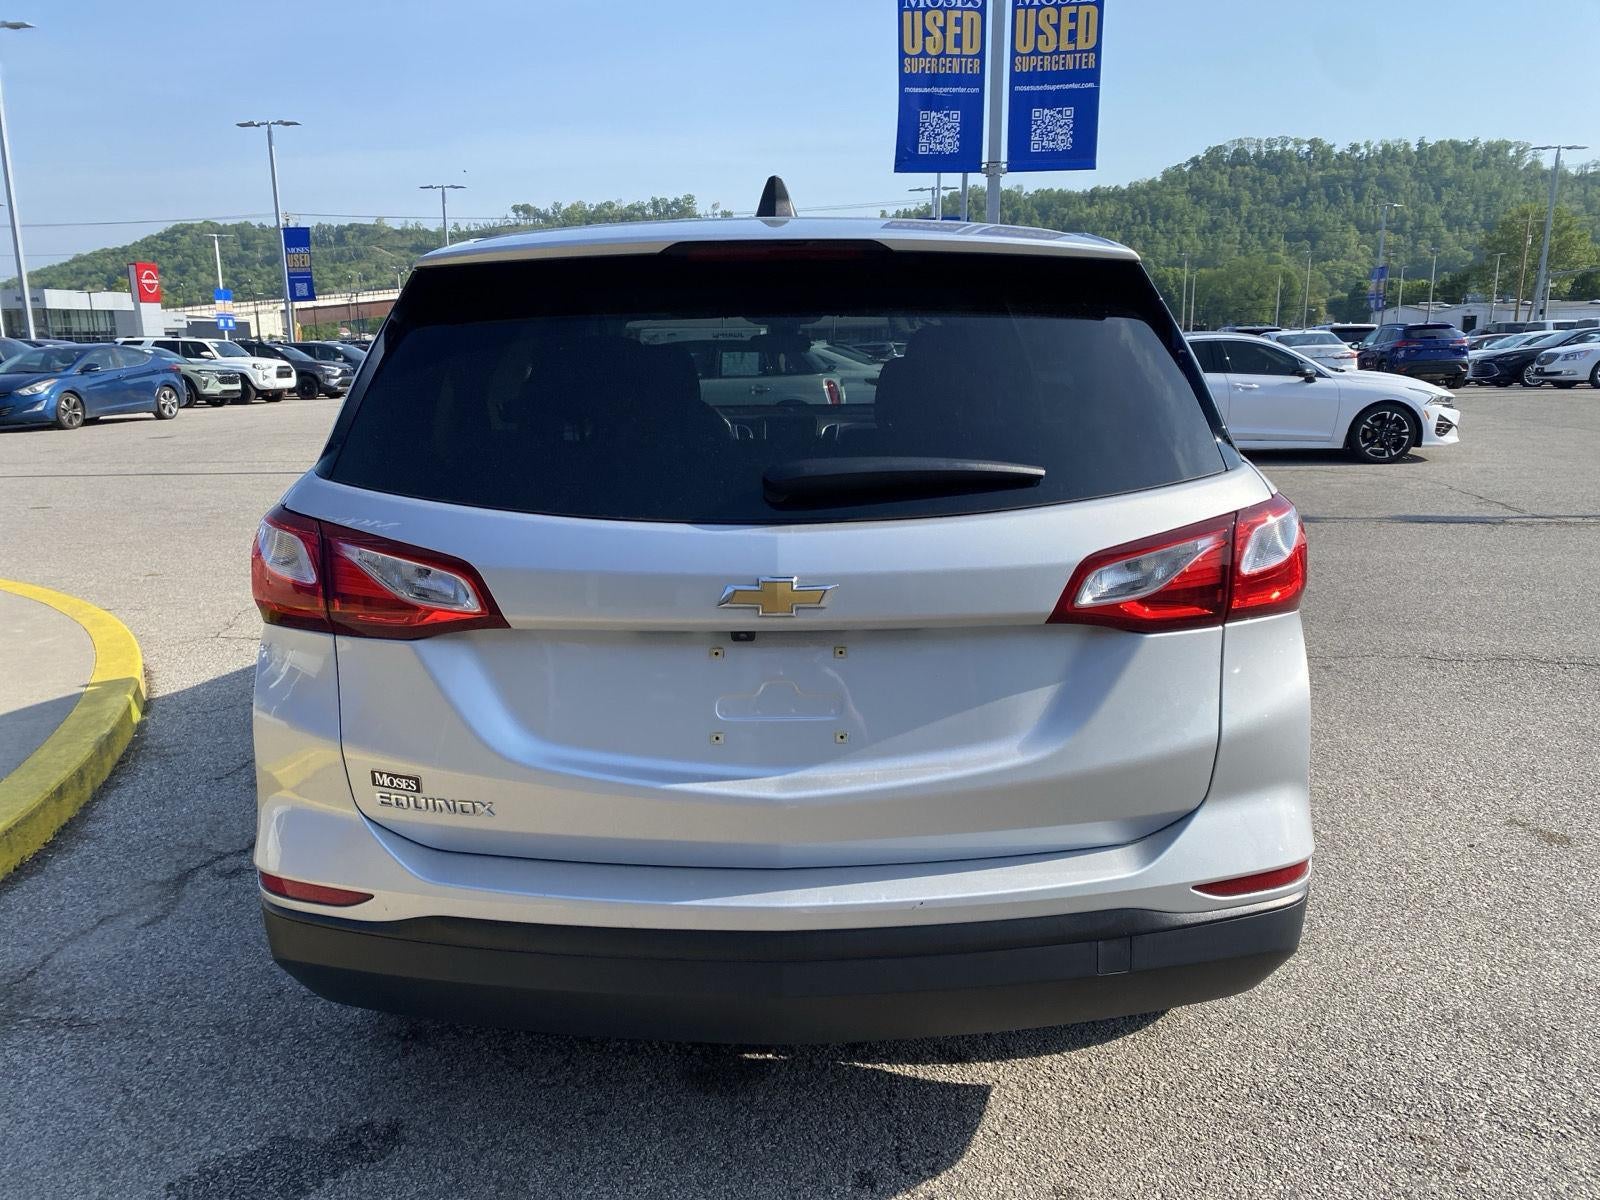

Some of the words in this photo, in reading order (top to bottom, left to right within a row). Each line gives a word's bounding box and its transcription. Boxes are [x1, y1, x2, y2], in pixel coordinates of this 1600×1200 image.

[903, 10, 982, 56] USED
[1015, 6, 1098, 54] USED
[904, 58, 980, 74] SUPERCENTER
[1015, 53, 1096, 72] SUPERCENTER
[904, 86, 980, 94] mosesusedsupercenter.com
[1014, 83, 1095, 91] mosesusedsupercenter.com
[287, 254, 310, 268] USED
[375, 772, 417, 791] MOSES
[375, 791, 496, 816] EQUINOX
